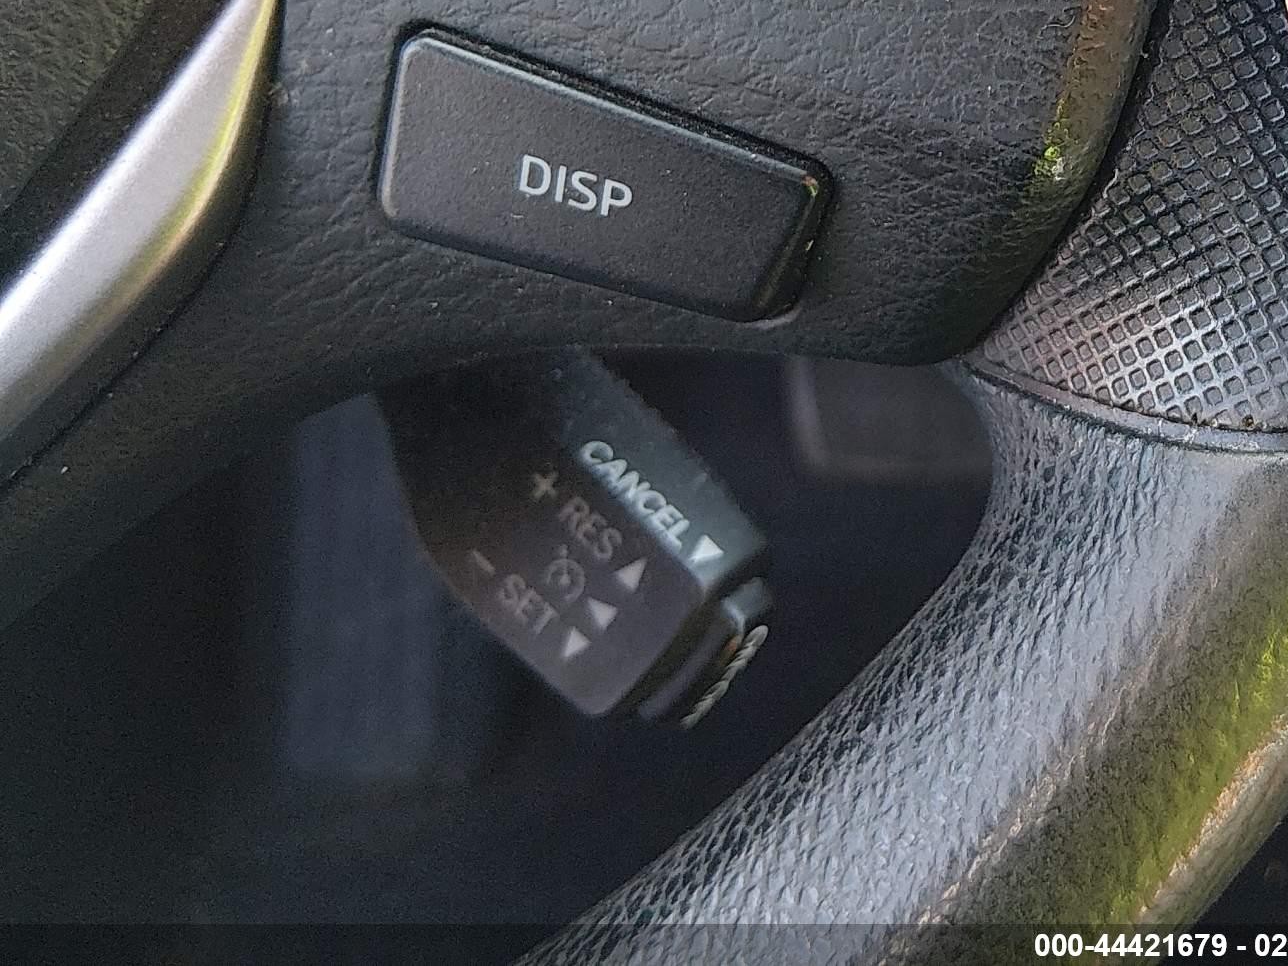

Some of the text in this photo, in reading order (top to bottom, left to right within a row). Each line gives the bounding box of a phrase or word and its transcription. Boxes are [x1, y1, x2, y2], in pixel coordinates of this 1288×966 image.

[519, 154, 633, 216] DISP
[558, 496, 622, 561] RES
[578, 440, 690, 554] CANCEL
[499, 574, 557, 634] SET
